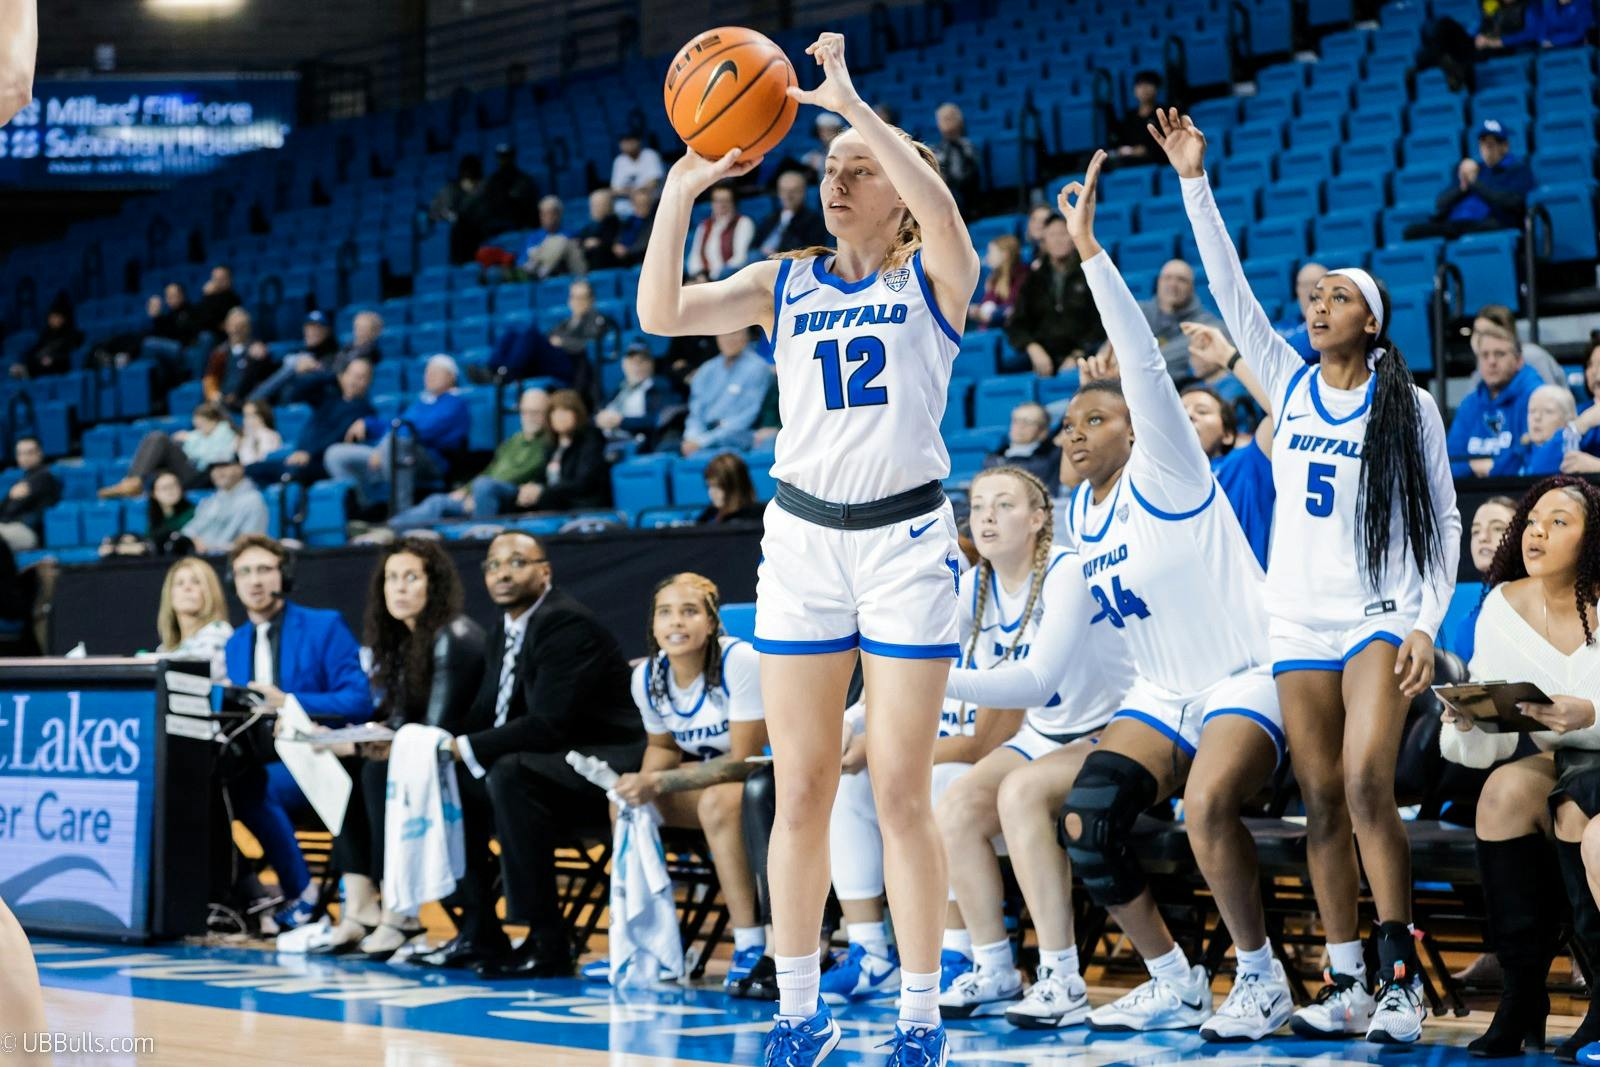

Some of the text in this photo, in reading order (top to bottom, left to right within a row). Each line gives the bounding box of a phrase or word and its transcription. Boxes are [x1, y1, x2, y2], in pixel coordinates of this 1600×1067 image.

[791, 303, 908, 337] BUFFALO
[813, 335, 889, 410] 12
[1287, 433, 1362, 459] BUFFAL
[1305, 461, 1337, 518] 5
[35, 791, 111, 843] Care
